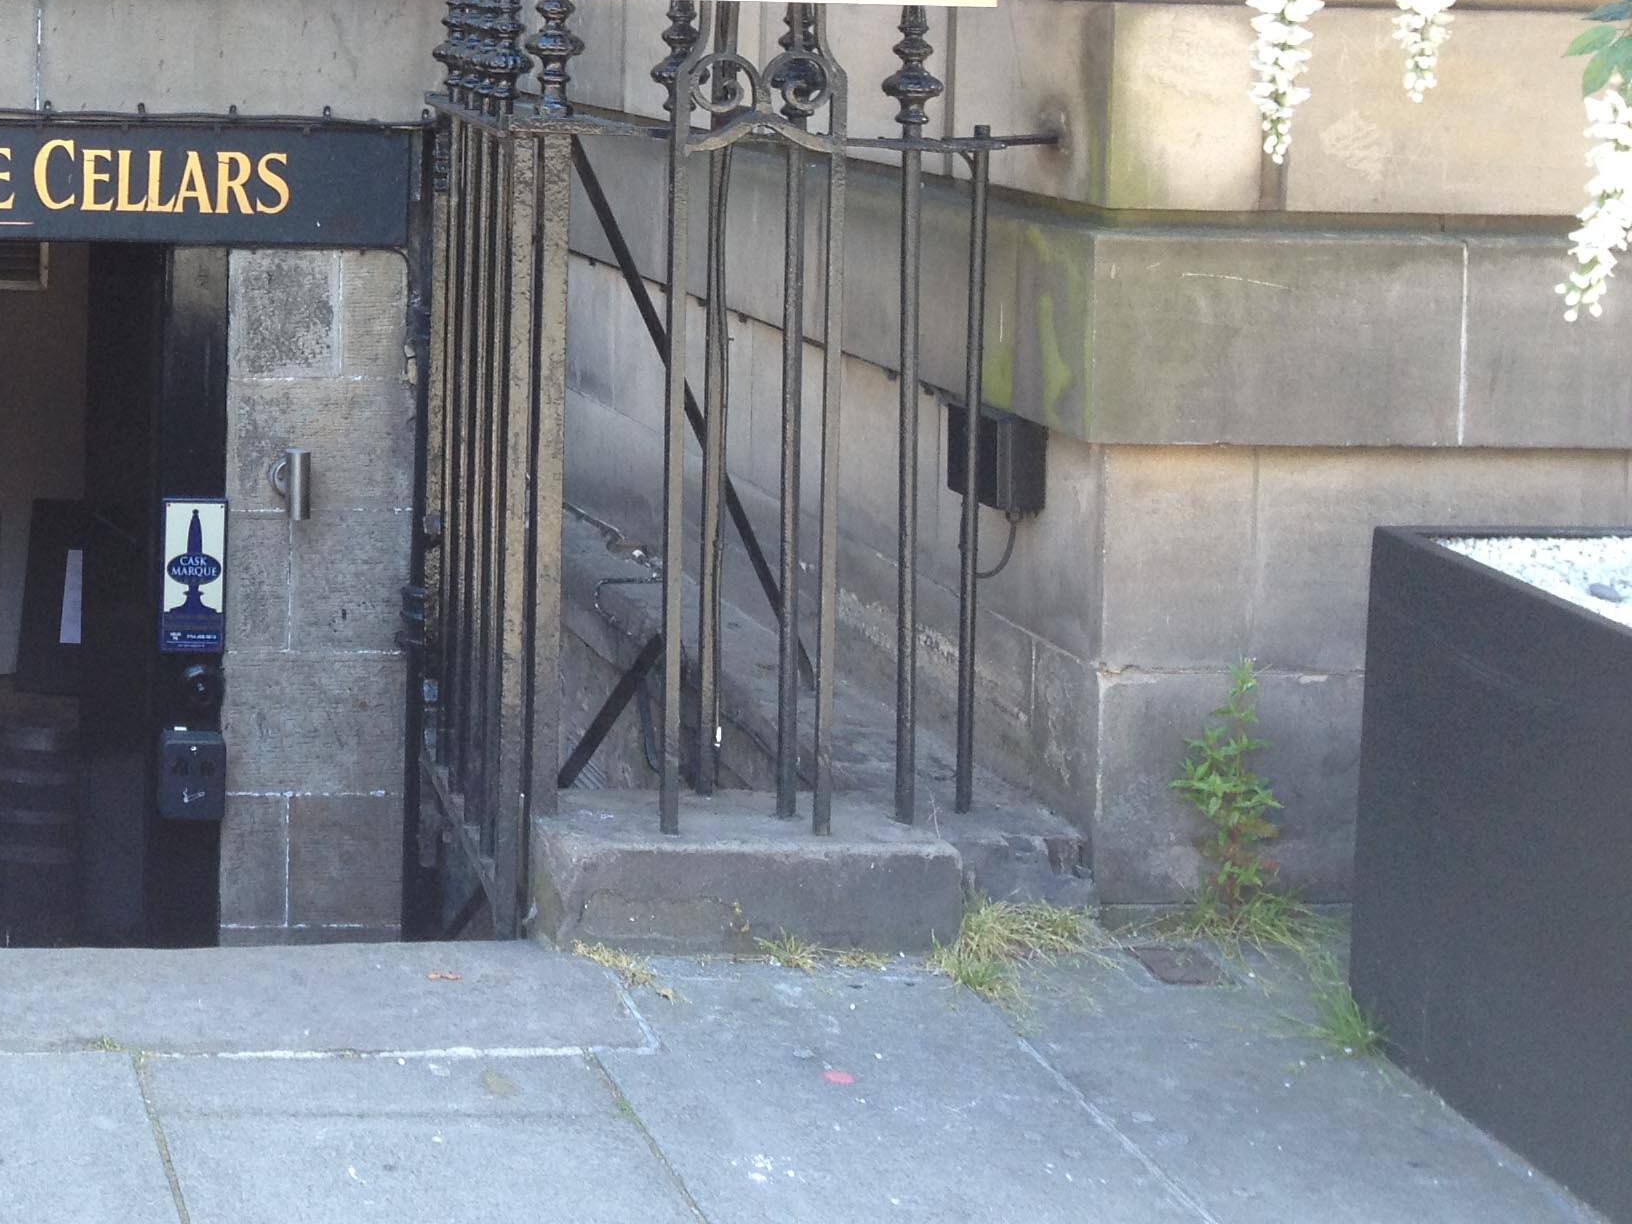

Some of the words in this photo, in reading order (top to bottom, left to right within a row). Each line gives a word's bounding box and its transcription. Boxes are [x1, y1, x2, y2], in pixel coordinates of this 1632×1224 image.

[33, 139, 290, 215] CELLARS
[179, 556, 208, 567] CASK
[171, 566, 218, 577] MARQUE
